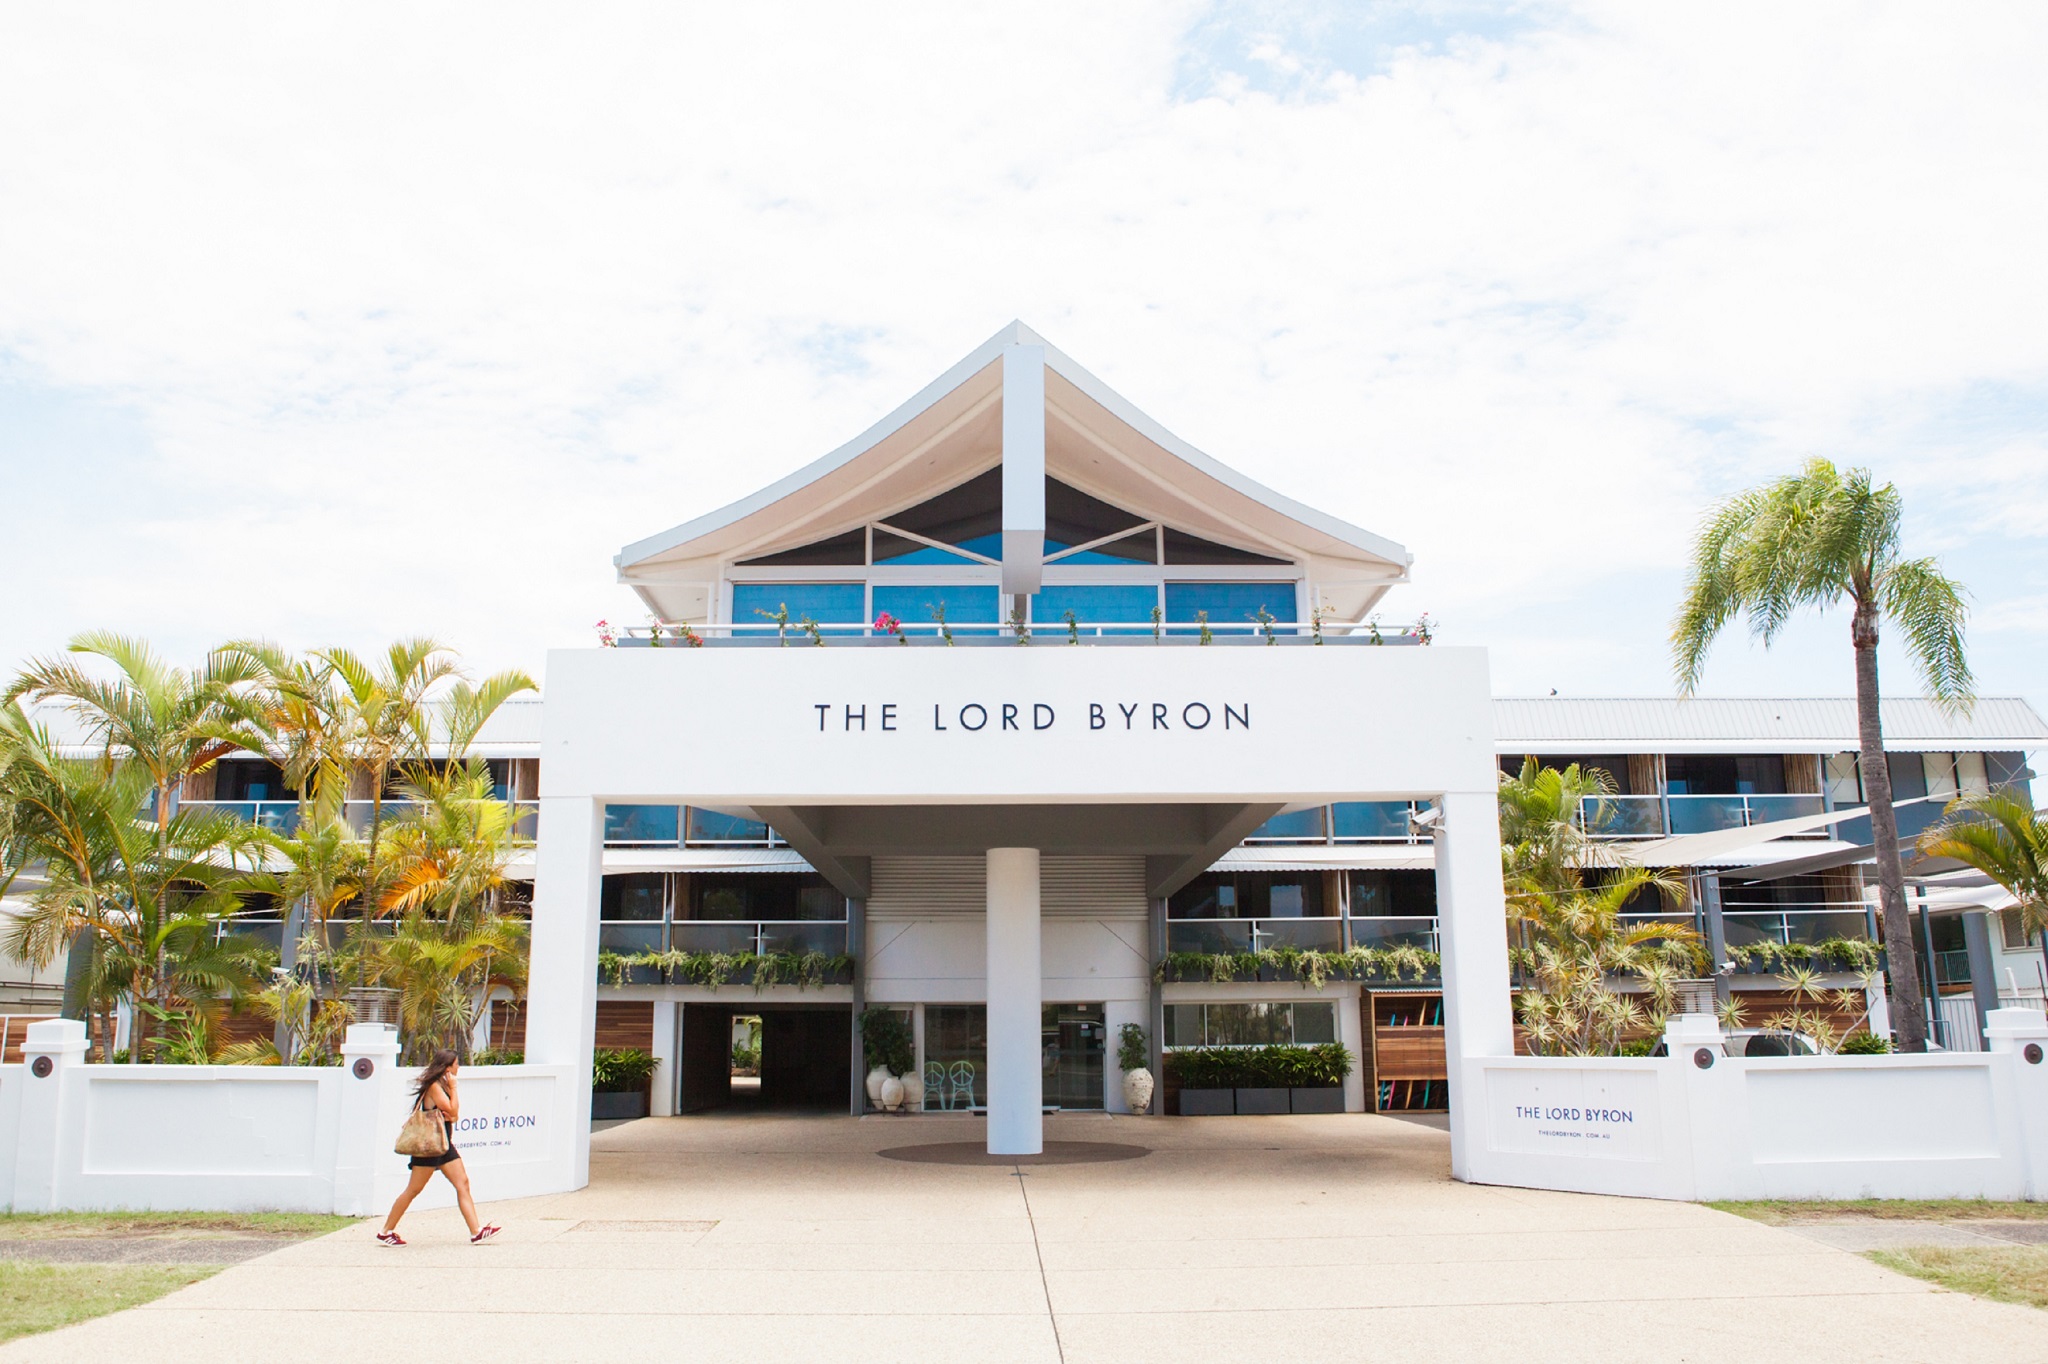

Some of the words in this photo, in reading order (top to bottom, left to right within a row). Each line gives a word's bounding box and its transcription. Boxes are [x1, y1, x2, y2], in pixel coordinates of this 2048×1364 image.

[814, 703, 898, 733] THE
[934, 703, 1055, 733] LORD
[1089, 701, 1250, 731] BYRON
[454, 1118, 488, 1131] LORD
[494, 1115, 536, 1129] BYRON
[1516, 1106, 1541, 1119] THE
[1545, 1107, 1581, 1121] LORD
[1585, 1108, 1633, 1123] BYRON
